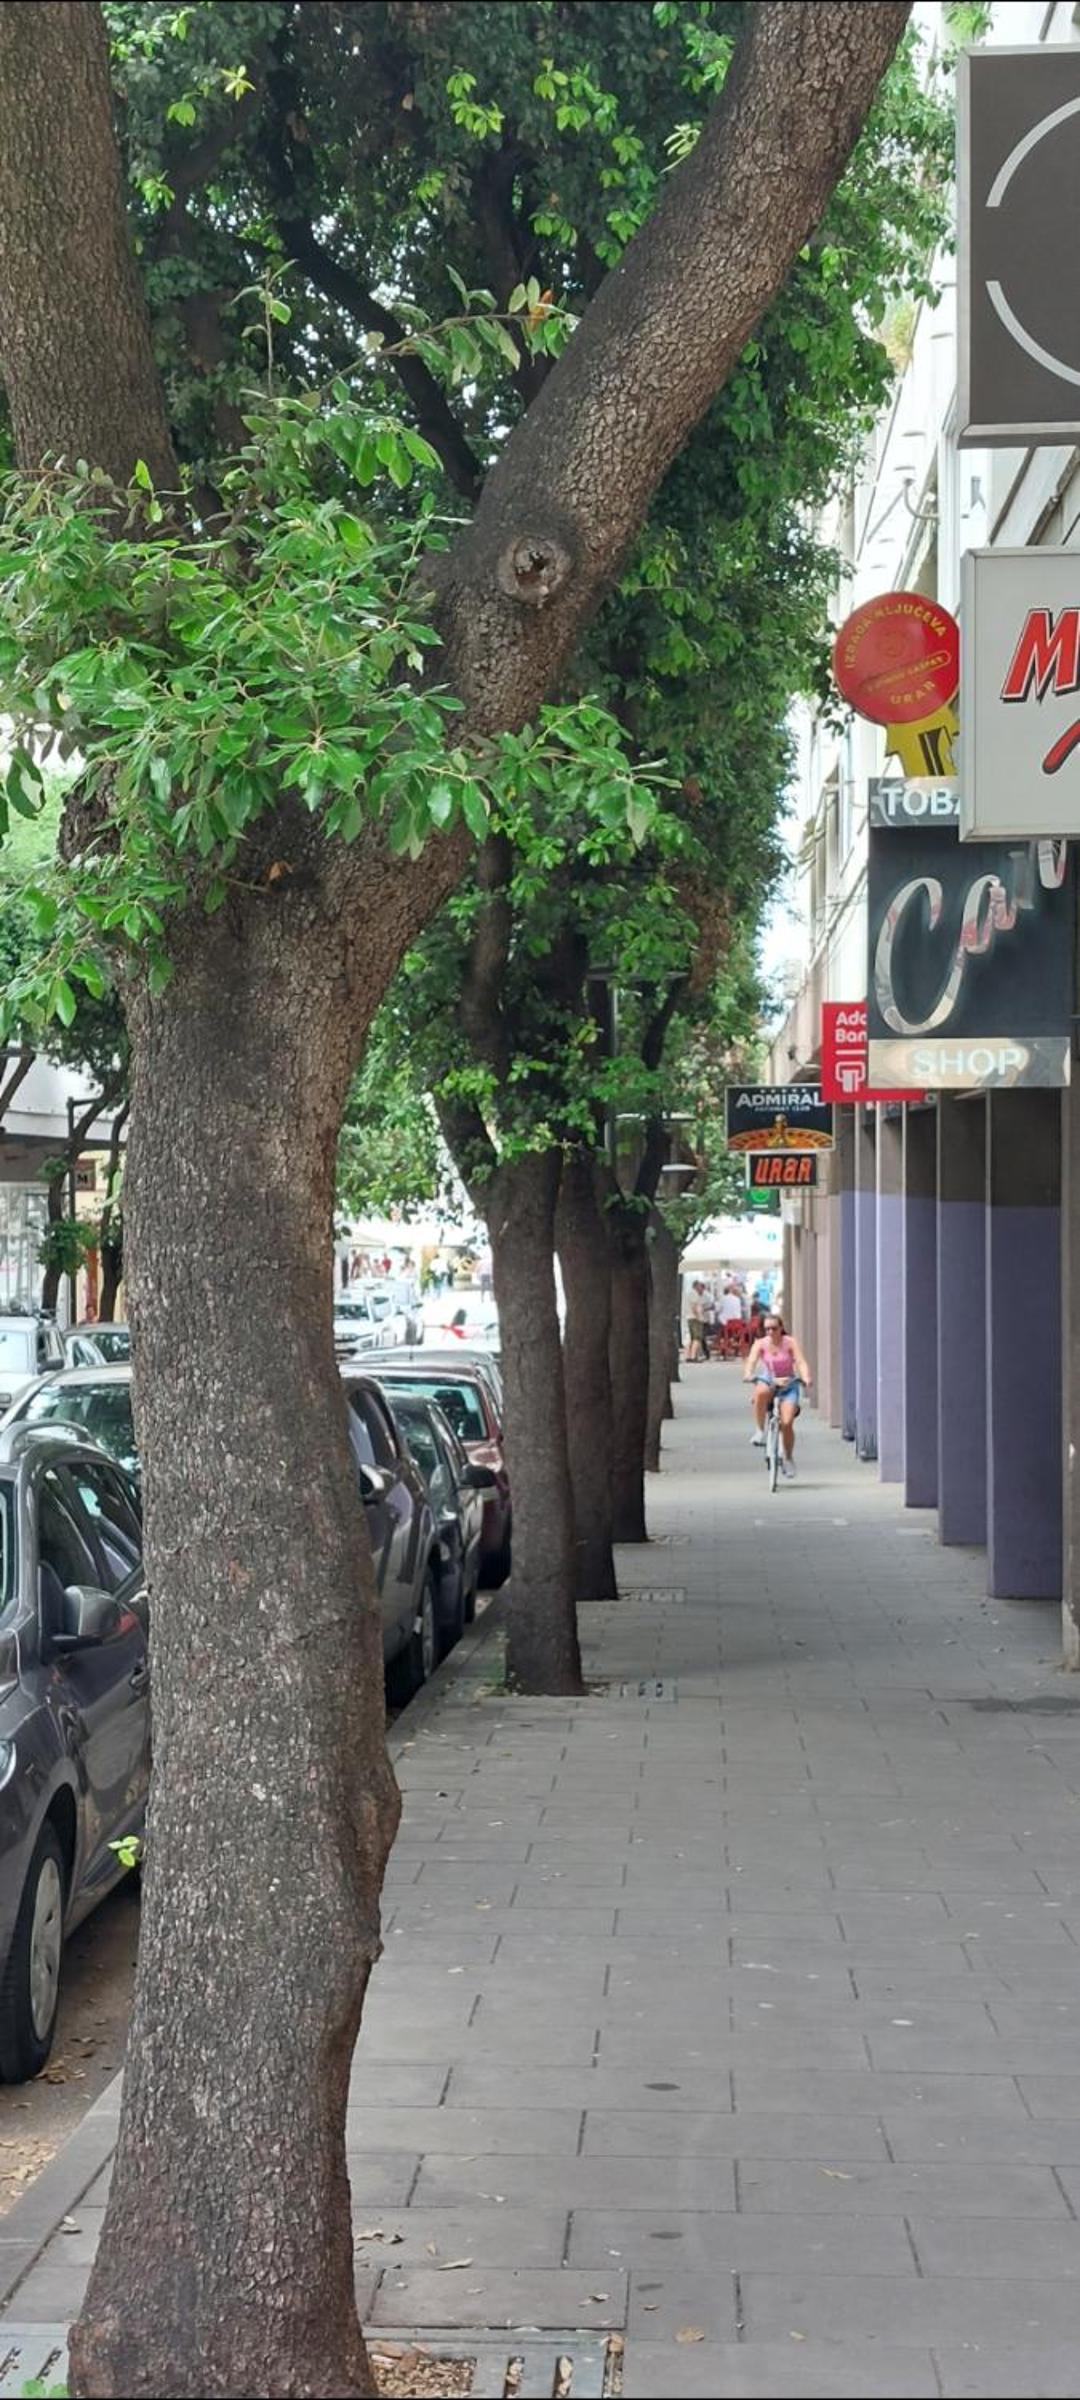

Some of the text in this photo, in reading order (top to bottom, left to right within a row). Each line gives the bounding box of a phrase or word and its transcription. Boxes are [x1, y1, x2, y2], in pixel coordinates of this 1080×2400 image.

[881, 786, 960, 816] TOB
[912, 1047, 1024, 1080] SHOP
[736, 1091, 826, 1108] ADMIRAL
